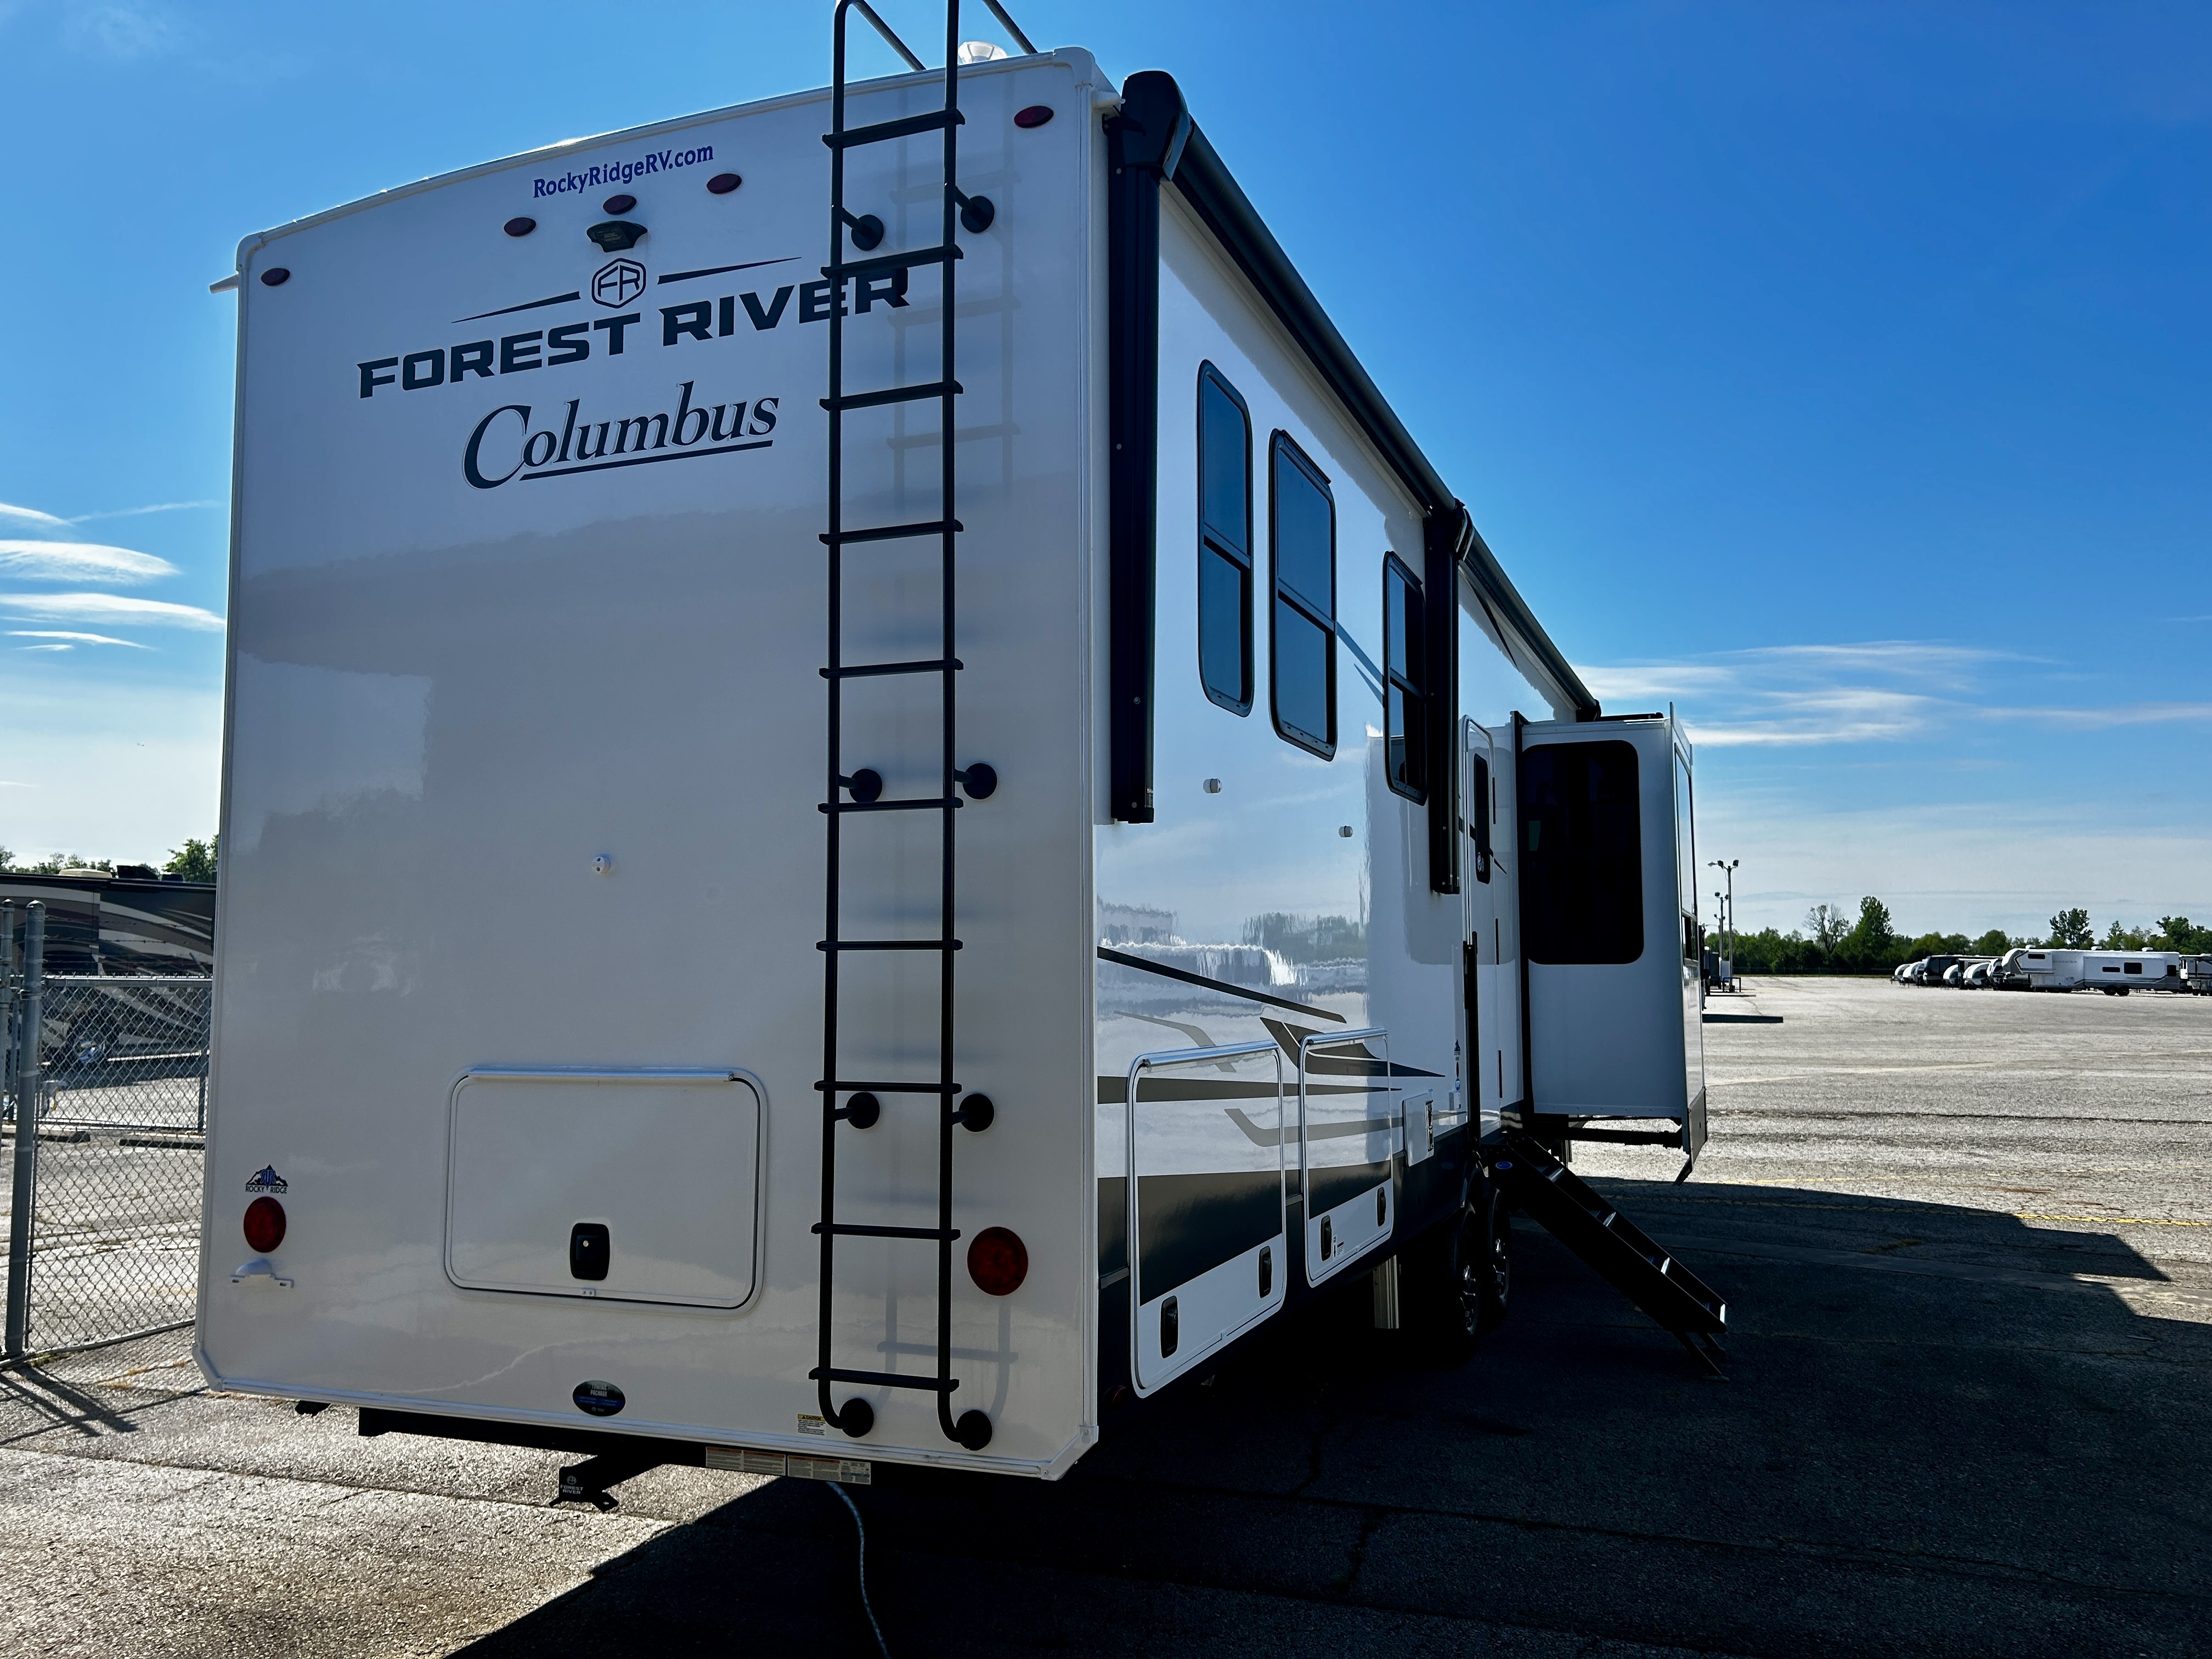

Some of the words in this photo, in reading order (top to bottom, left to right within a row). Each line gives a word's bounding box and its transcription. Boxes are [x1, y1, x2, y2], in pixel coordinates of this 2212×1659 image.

[533, 145, 714, 198] RockyRidgeRV.com
[357, 313, 641, 399] FOREST
[658, 267, 910, 347] RIVER
[462, 380, 780, 490] Columbus
[245, 1185, 264, 1193] ROCKY
[590, 1389, 607, 1397] PACKAGE
